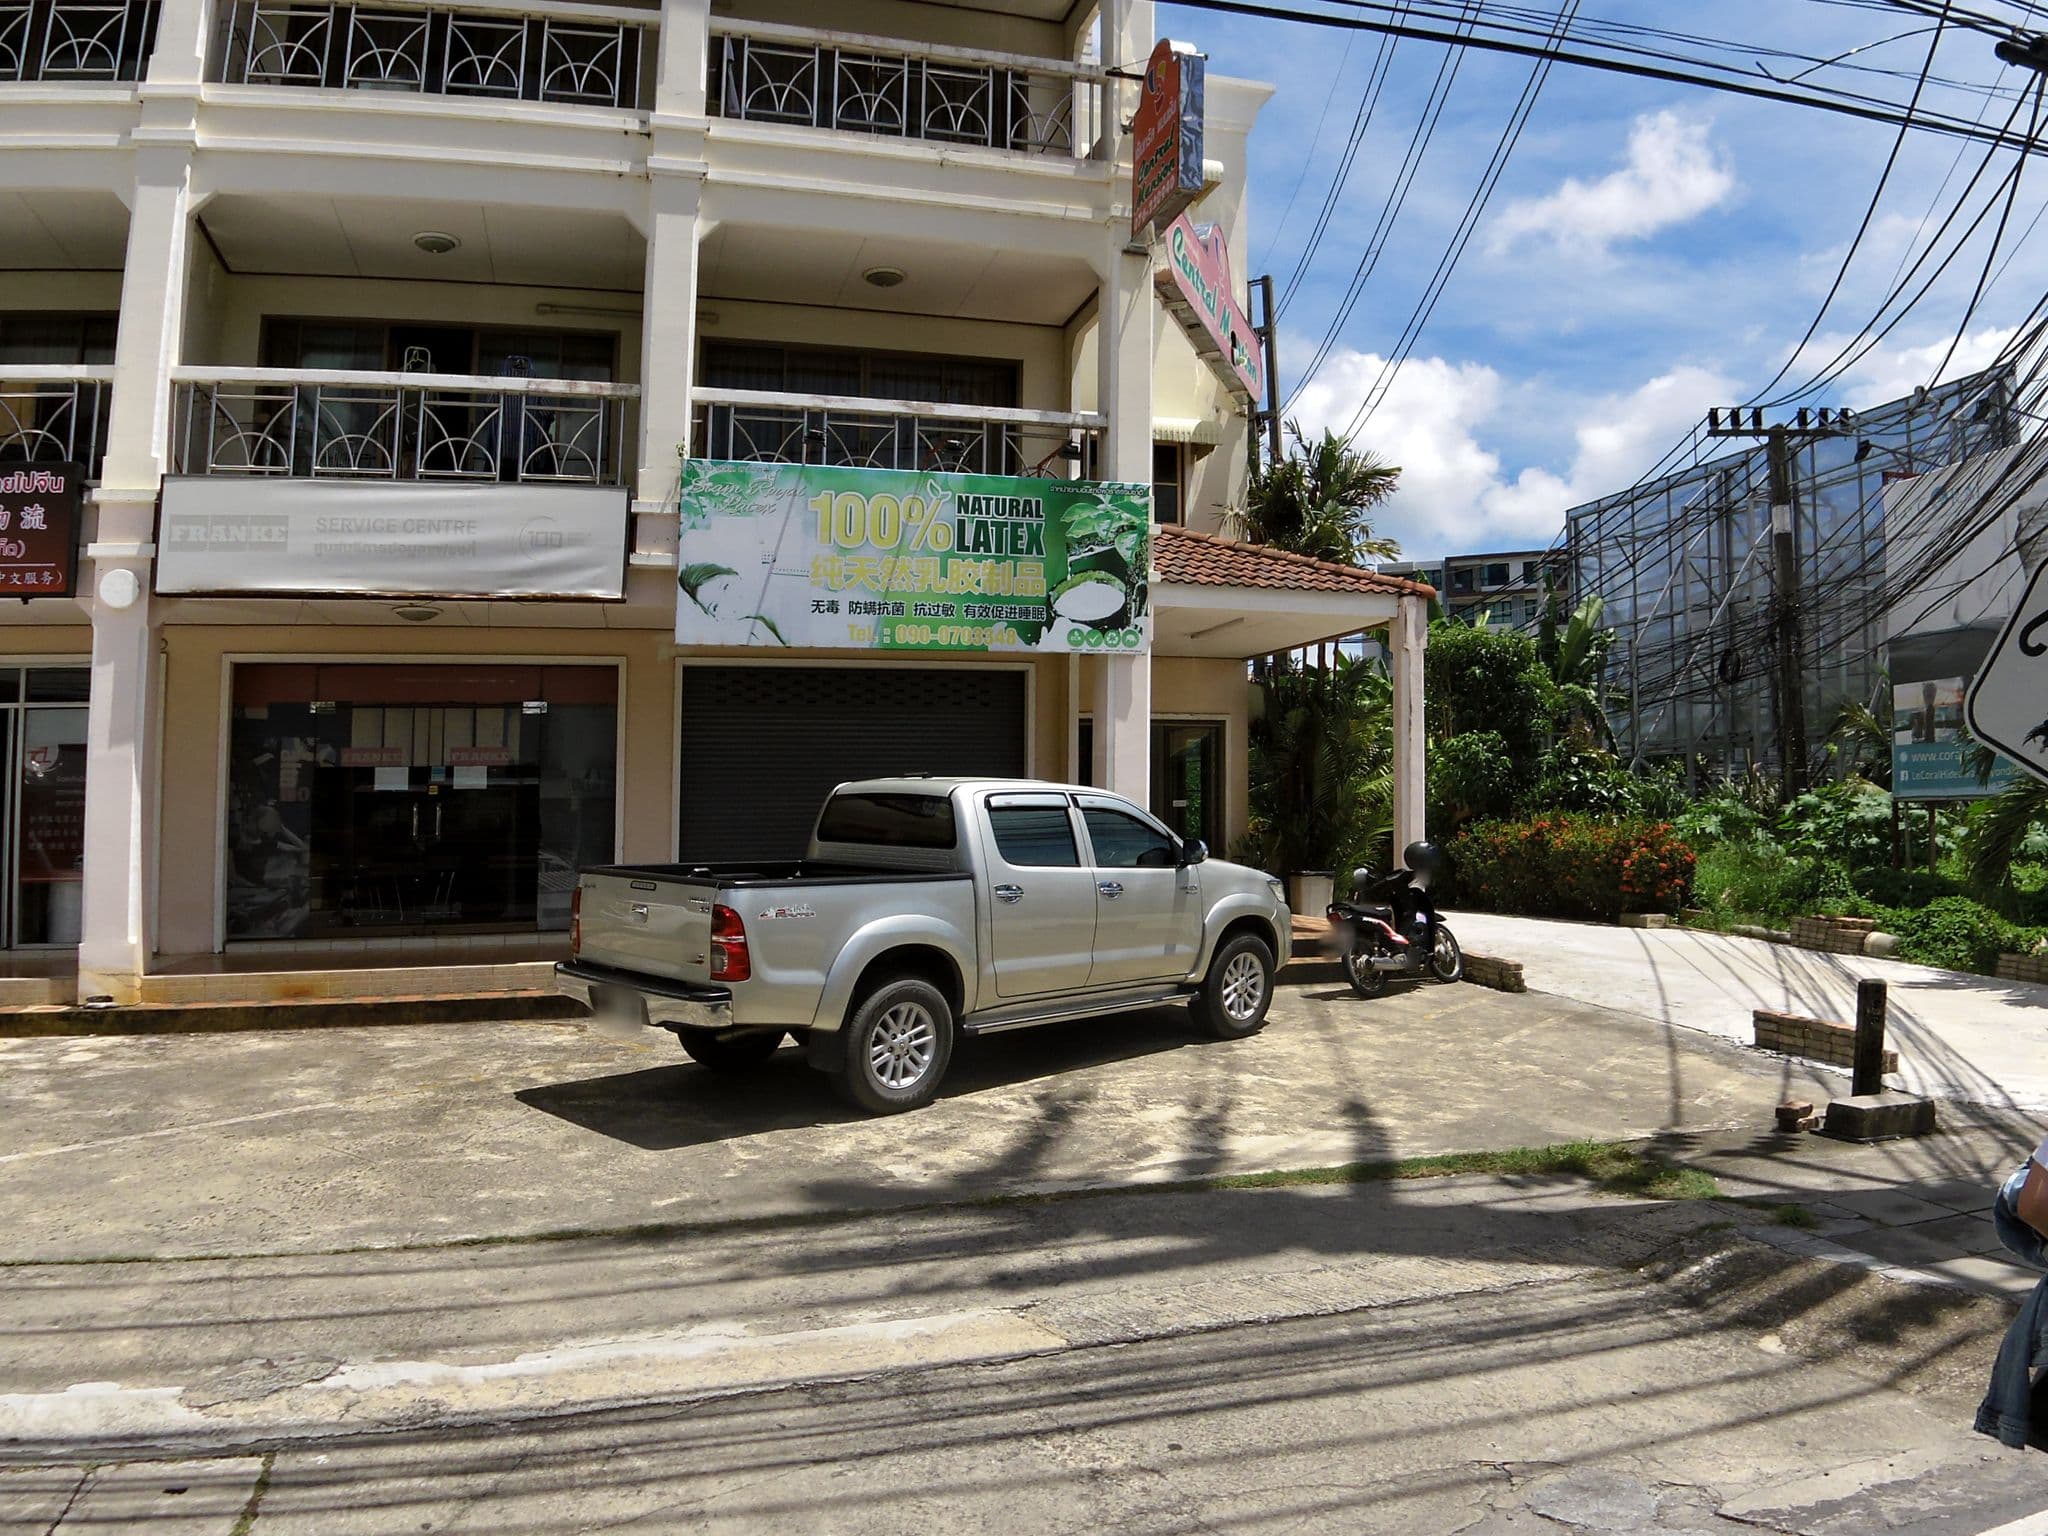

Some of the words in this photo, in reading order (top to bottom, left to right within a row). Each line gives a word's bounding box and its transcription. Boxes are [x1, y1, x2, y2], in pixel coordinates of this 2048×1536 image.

[1173, 225, 1218, 320] Central
[316, 517, 397, 535] SERVICE
[402, 518, 478, 535] CENTRE
[809, 490, 953, 551] 100%
[956, 494, 1045, 519] NATURAL
[956, 518, 1046, 557] LATEX
[810, 555, 1047, 597] 纯天然乳胶制品
[811, 600, 840, 614] 无毒
[848, 600, 905, 617] 防螨抗菌
[914, 603, 955, 617] 抗过敏
[963, 604, 1046, 621] 有效促进睡眠
